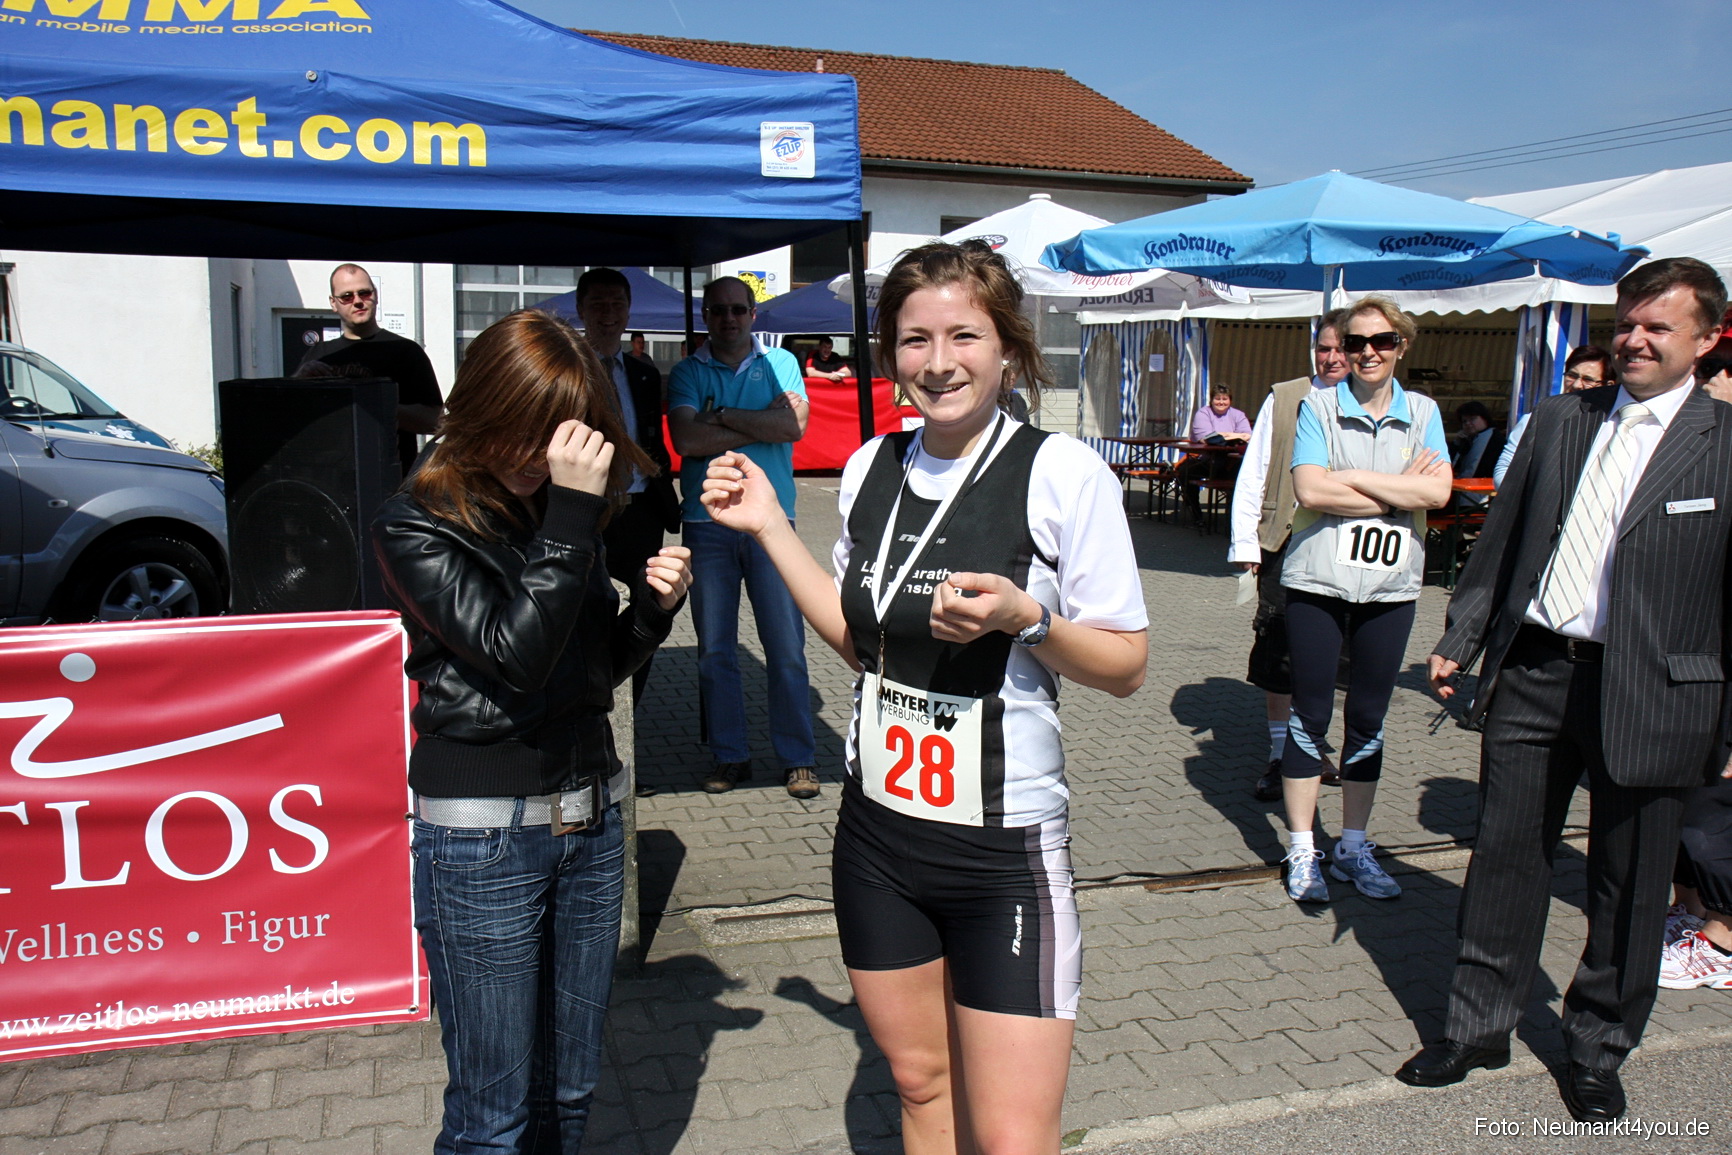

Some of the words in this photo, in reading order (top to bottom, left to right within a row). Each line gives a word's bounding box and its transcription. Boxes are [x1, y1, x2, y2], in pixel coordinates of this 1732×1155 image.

[35, 18, 131, 34] mobile
[139, 23, 224, 35] media
[232, 20, 373, 34] association
[1144, 232, 1236, 265] Kondrauer
[1376, 232, 1482, 258] Kondrauer
[1349, 524, 1402, 567] 100
[880, 685, 930, 714] MEYER
[880, 702, 930, 726] WERBUNG
[884, 724, 955, 808] 28
[221, 910, 331, 953] Figur
